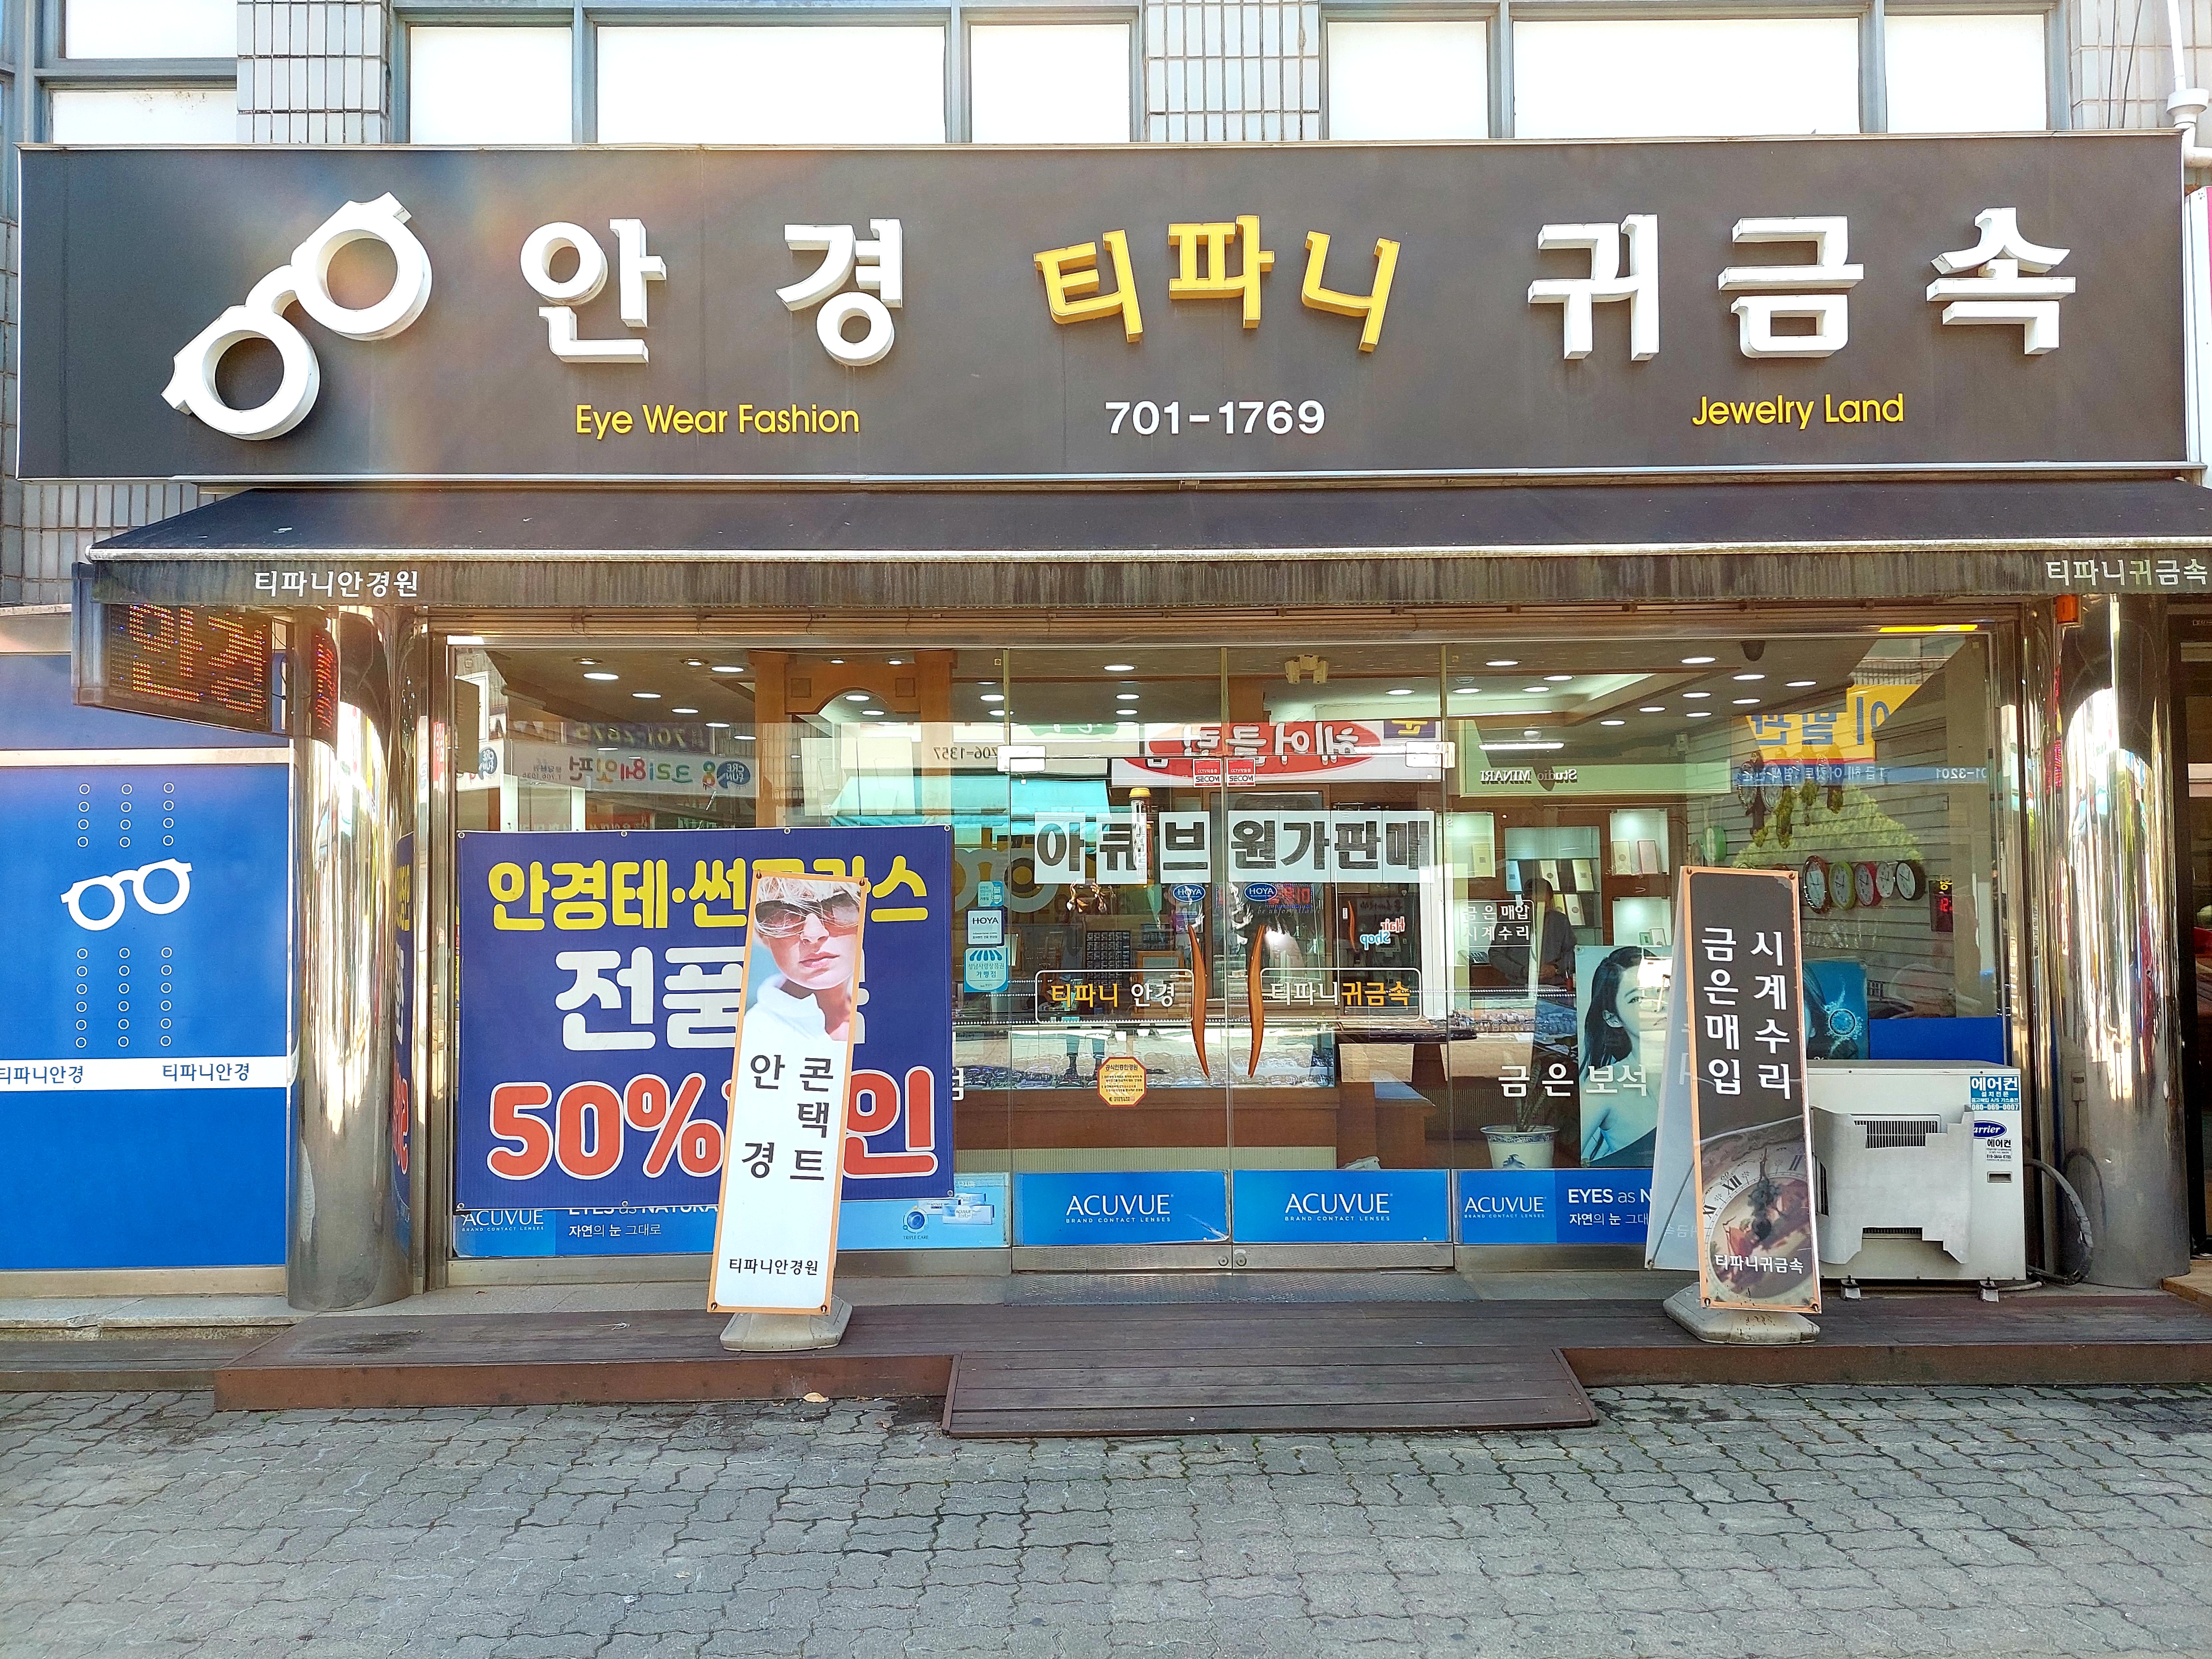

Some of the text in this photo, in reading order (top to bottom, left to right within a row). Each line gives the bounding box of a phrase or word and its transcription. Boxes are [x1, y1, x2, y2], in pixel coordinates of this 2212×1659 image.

[520, 208, 2076, 366] 안경 티파니 귀금속
[576, 404, 859, 440] Eye Wear Fashion
[1106, 400, 1325, 435] 701-1769
[1692, 393, 1905, 429] Jewelry Land
[255, 570, 418, 597] 티파니안경원
[2046, 559, 2208, 586] 티파니귀금속
[1037, 820, 1430, 871] 아큐브 원가판매
[489, 854, 929, 930] 안경테·썬스
[1248, 888, 1274, 896] HOYA
[1050, 983, 1175, 1007] 티파니 안경
[1702, 927, 1742, 1096] 금은매입
[1750, 931, 1791, 1100] 시계수리
[163, 1063, 250, 1082] 티파니안경
[1586, 1063, 1647, 1097] 보석
[1971, 1077, 2018, 1091] 에어컨
[487, 1073, 724, 1181] 50%
[742, 1055, 785, 1178] 안경
[790, 1057, 834, 1181] 콘택트
[1973, 1125, 2000, 1134] arrier
[1987, 1138, 2011, 1148] 에어컨
[1066, 1194, 1170, 1216] ACUVUE
[1285, 1193, 1390, 1214] ACUVUE
[1464, 1197, 1545, 1213] ACUVUE
[1568, 1189, 1614, 1204] EYES
[1618, 1191, 1635, 1204] as
[463, 1209, 544, 1226] ACUVUE
[1569, 1213, 1648, 1225] 자연의 눈 그대
[568, 1224, 661, 1237] 자연의 눈 그대로
[729, 1259, 818, 1276] 티파니안경원
[1715, 1254, 1804, 1274] 티파니귀금속
